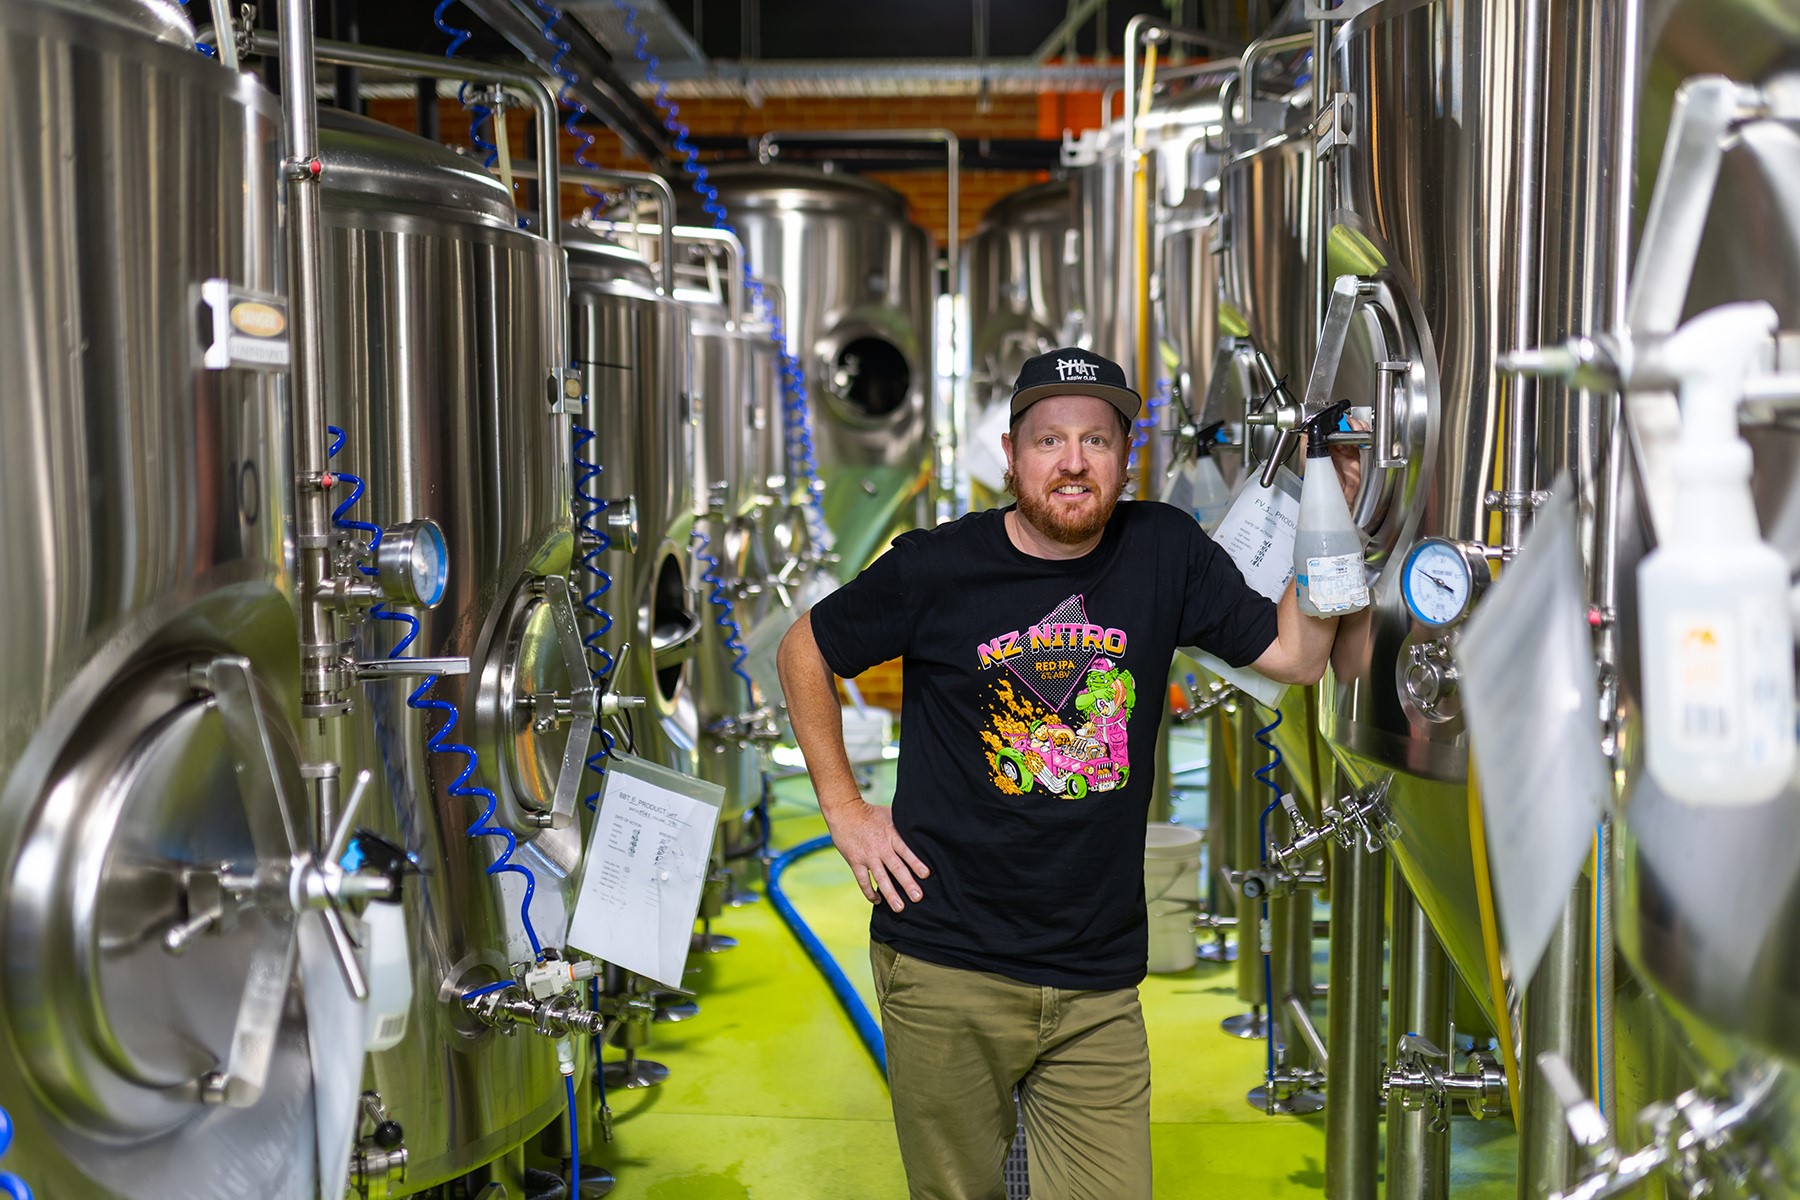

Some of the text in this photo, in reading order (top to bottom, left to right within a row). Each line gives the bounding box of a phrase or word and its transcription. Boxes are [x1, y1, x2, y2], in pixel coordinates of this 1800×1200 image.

[1055, 358, 1099, 380] PHAT
[1254, 498, 1266, 507] FV
[977, 623, 1128, 670] NZ NITRO
[1035, 660, 1076, 671] RED IPA
[1041, 670, 1071, 680] 6% ABV
[637, 799, 667, 815] PRODUCT
